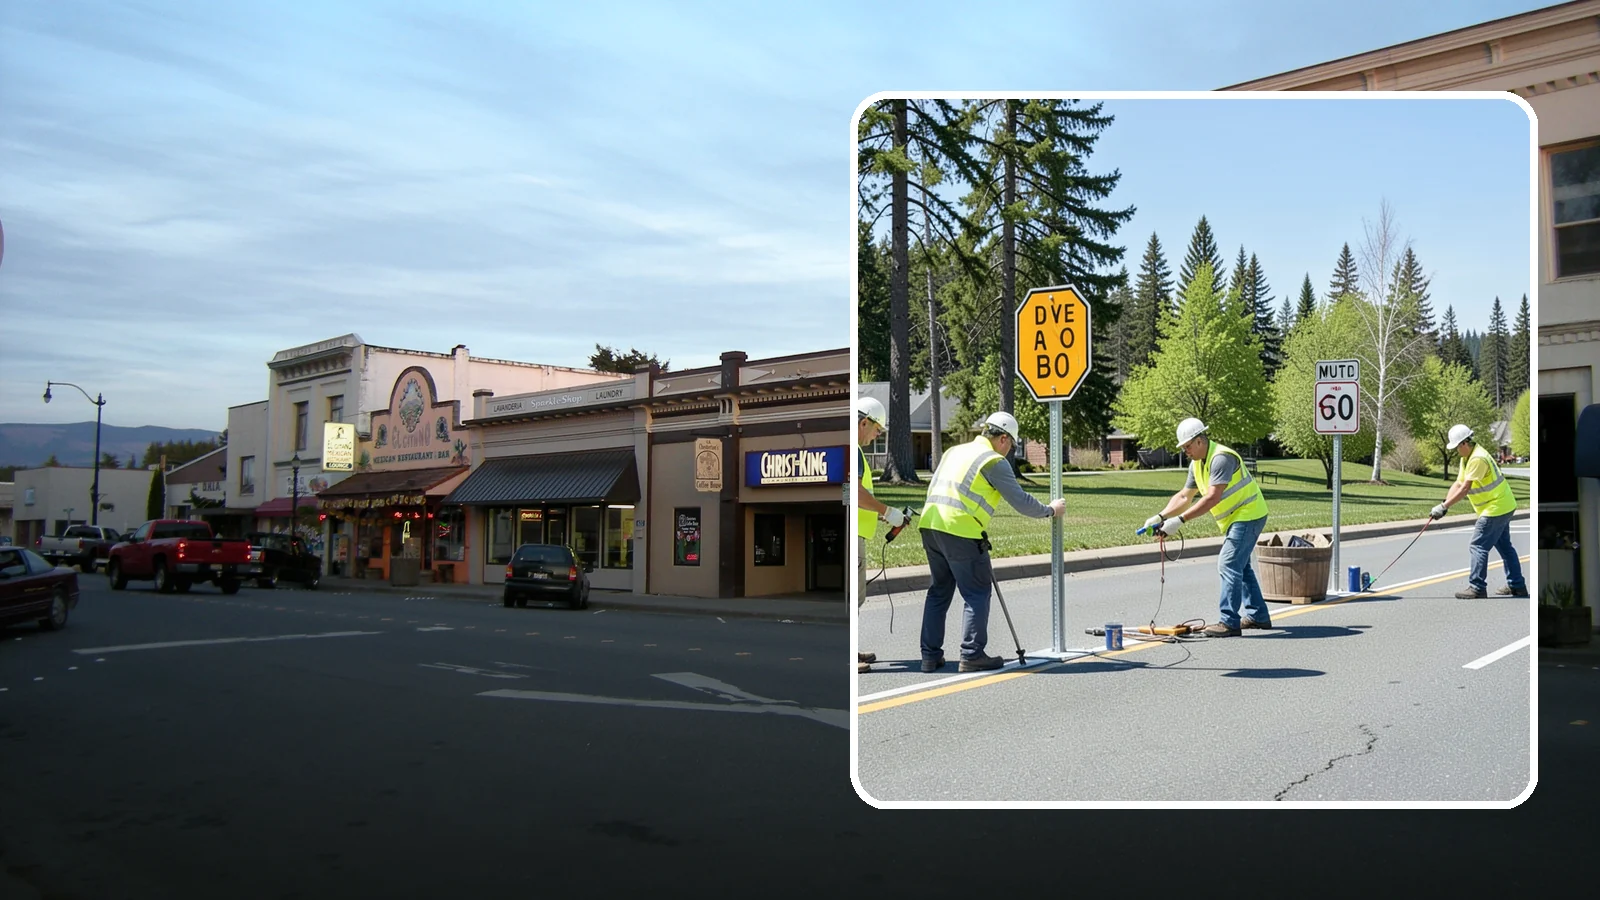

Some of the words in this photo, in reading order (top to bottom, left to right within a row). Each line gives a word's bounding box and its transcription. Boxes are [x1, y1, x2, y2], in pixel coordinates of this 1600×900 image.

[1035, 303, 1075, 325] DVE
[1034, 330, 1047, 351] A
[1037, 353, 1070, 379] BO
[531, 398, 559, 409] Sparkle
[562, 394, 582, 404] Shop
[595, 389, 623, 400] LAUNDRY
[493, 402, 522, 413] LAVANDERIA
[1318, 393, 1354, 421] 60
[373, 456, 396, 464] MEXICAN
[397, 452, 433, 462] RESTAURANT
[438, 450, 449, 459] BAR
[761, 452, 797, 477] CHRIST
[799, 450, 827, 476] KING
